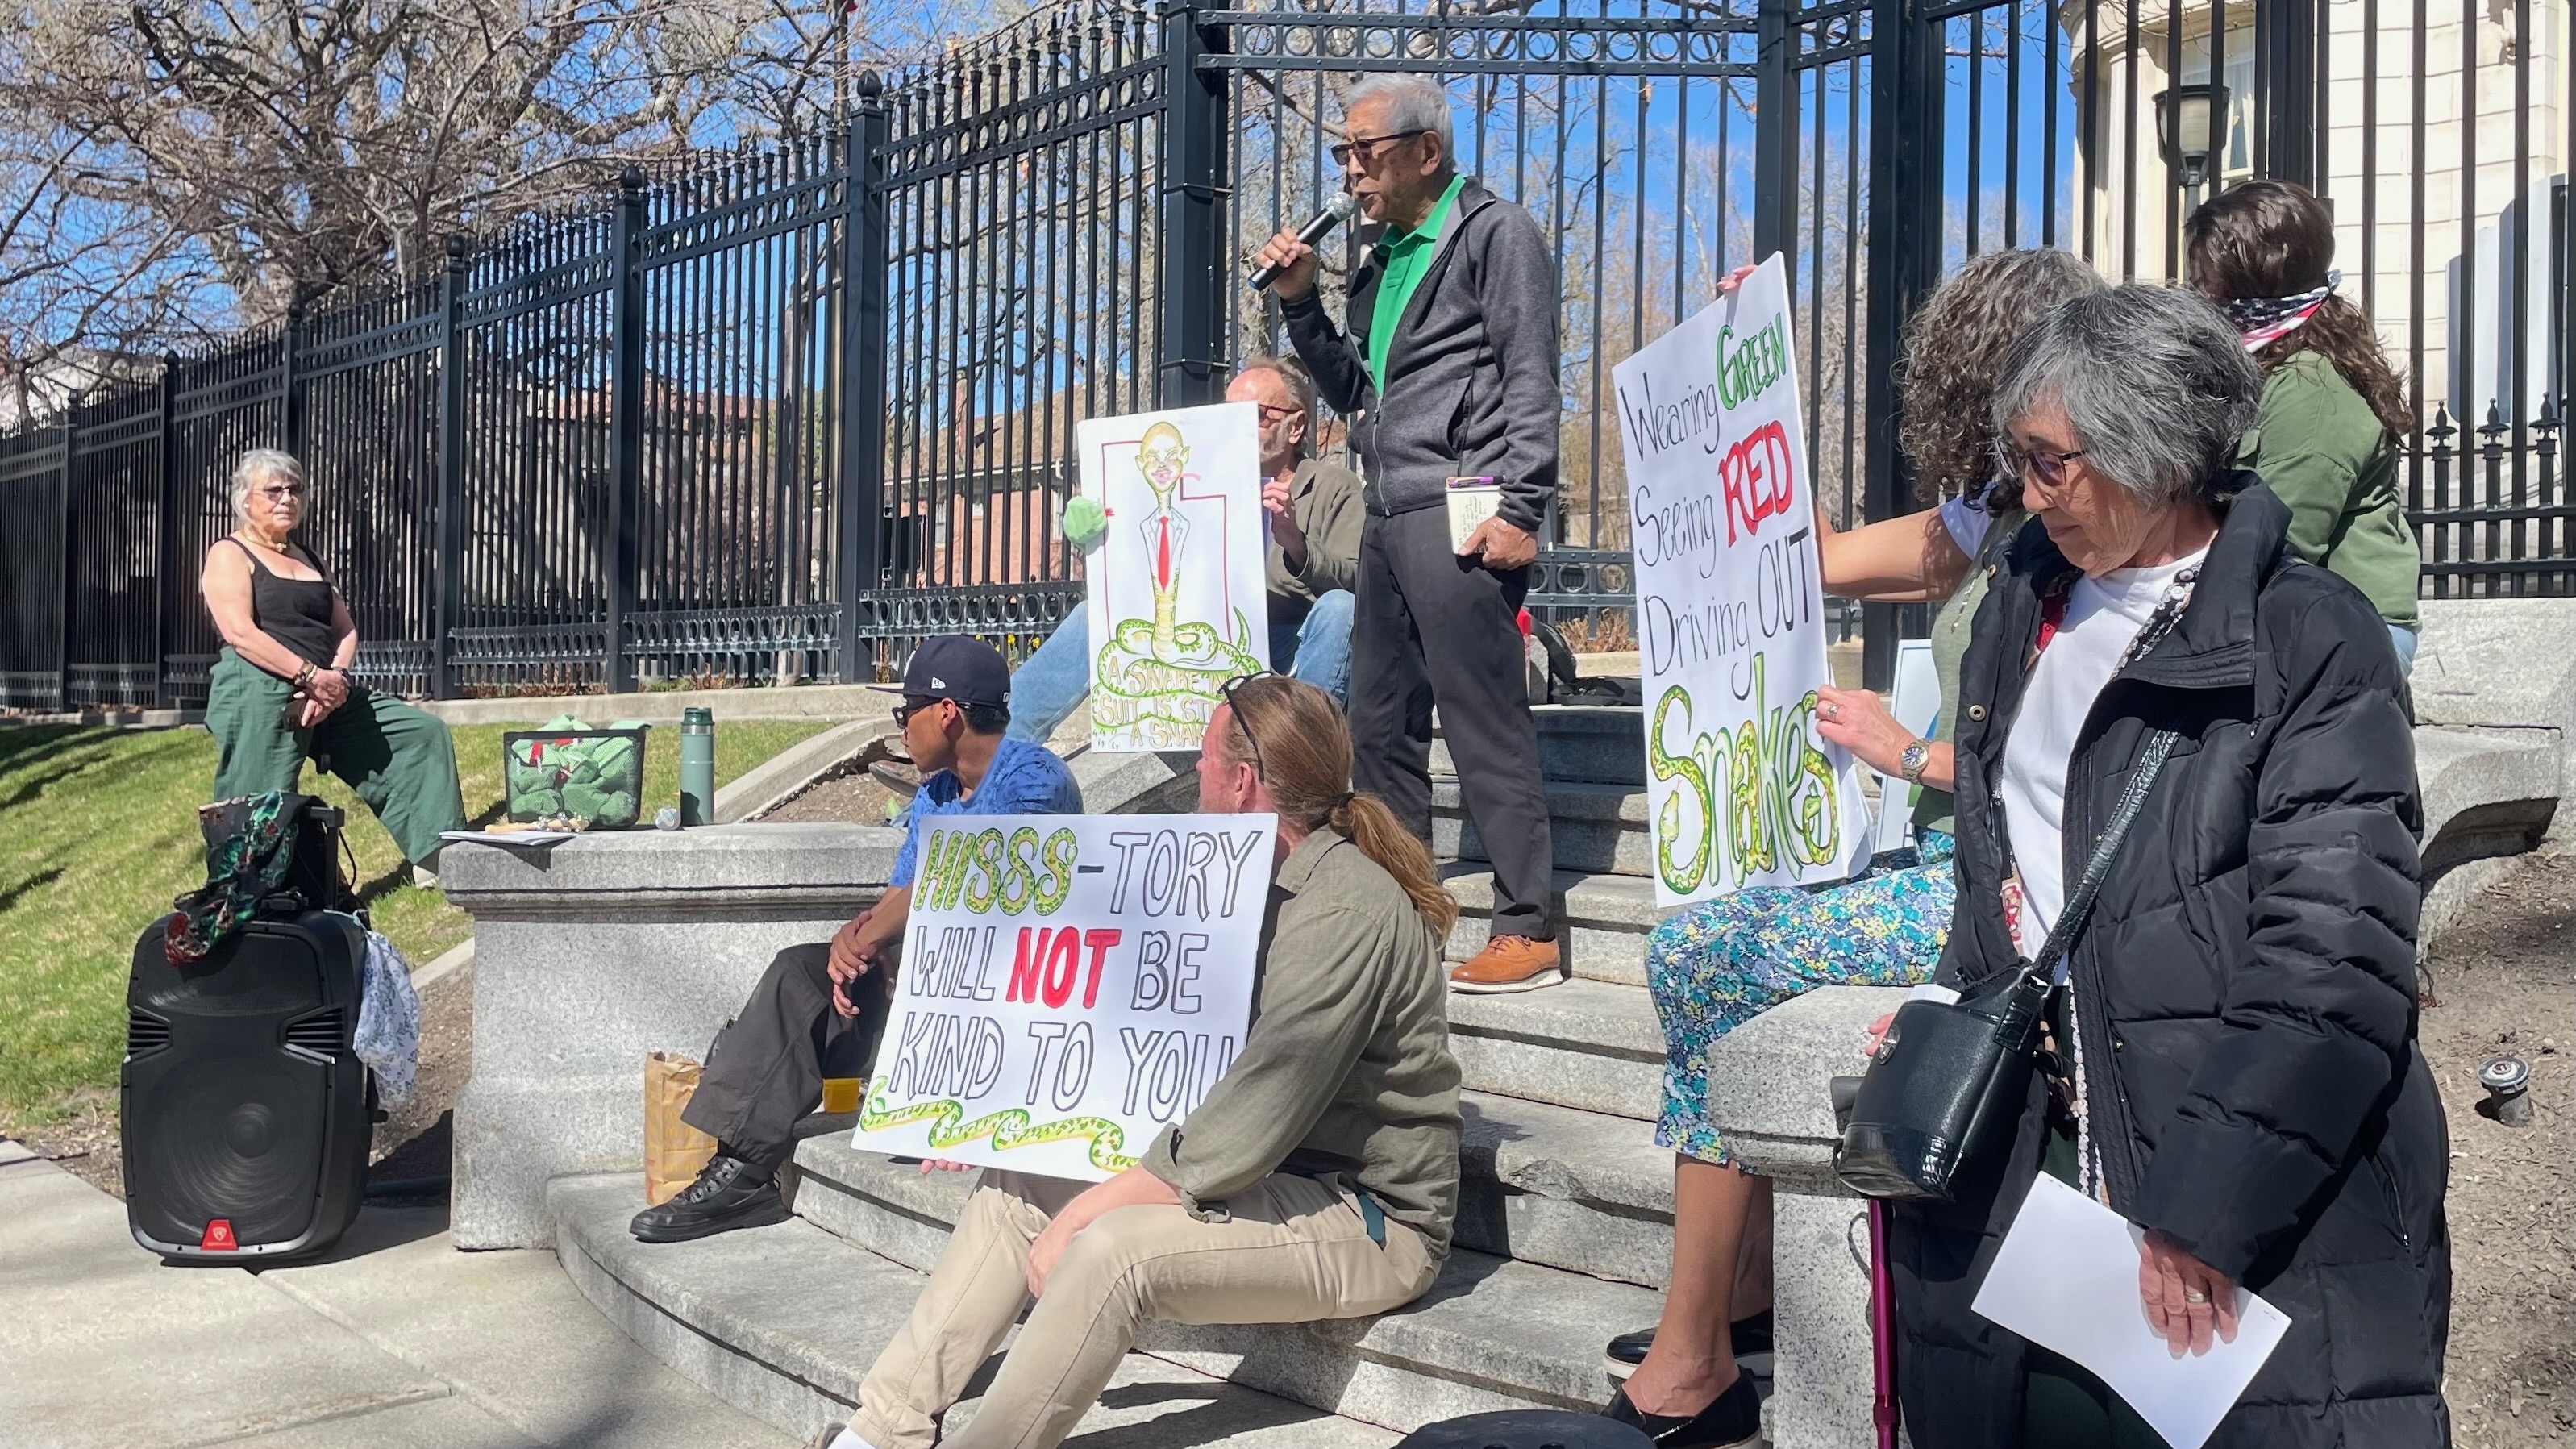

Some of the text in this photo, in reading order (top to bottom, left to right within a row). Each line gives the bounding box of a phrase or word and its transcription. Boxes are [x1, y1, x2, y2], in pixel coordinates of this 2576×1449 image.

[1620, 312, 1787, 462] Wearing GREEN
[1635, 420, 1793, 579] Seeing RED
[1644, 527, 1810, 701] Driving OUT
[1099, 694, 1215, 725] SUIT IS STI
[1108, 656, 1121, 685] A
[1129, 664, 1199, 694] SNAKE
[1130, 719, 1205, 749] A SNAK
[1651, 652, 1839, 894] Snakes
[910, 926, 1209, 1014] WILL NOT BE
[889, 1012, 1234, 1122] KIND TO YOU
